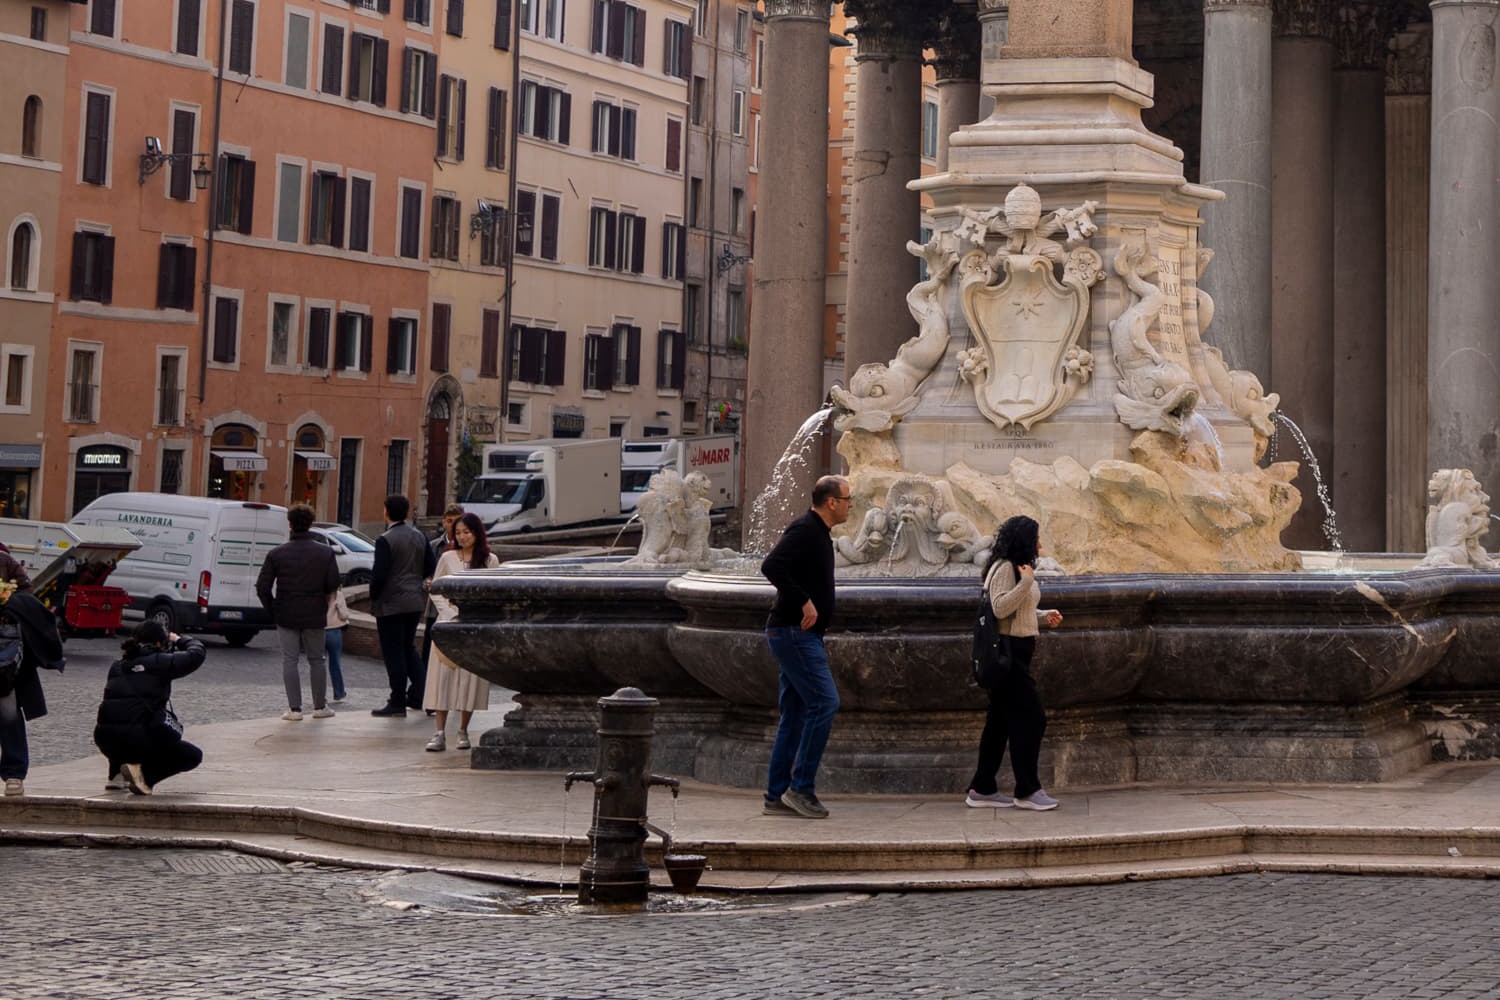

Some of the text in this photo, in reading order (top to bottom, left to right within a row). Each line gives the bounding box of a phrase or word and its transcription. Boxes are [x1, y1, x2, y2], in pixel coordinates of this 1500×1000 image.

[84, 453, 121, 464] miramira
[703, 448, 730, 465] MARR
[236, 460, 256, 470] PIZZA
[313, 460, 331, 470] PIZZA
[117, 513, 173, 528] LAVANDERIA
